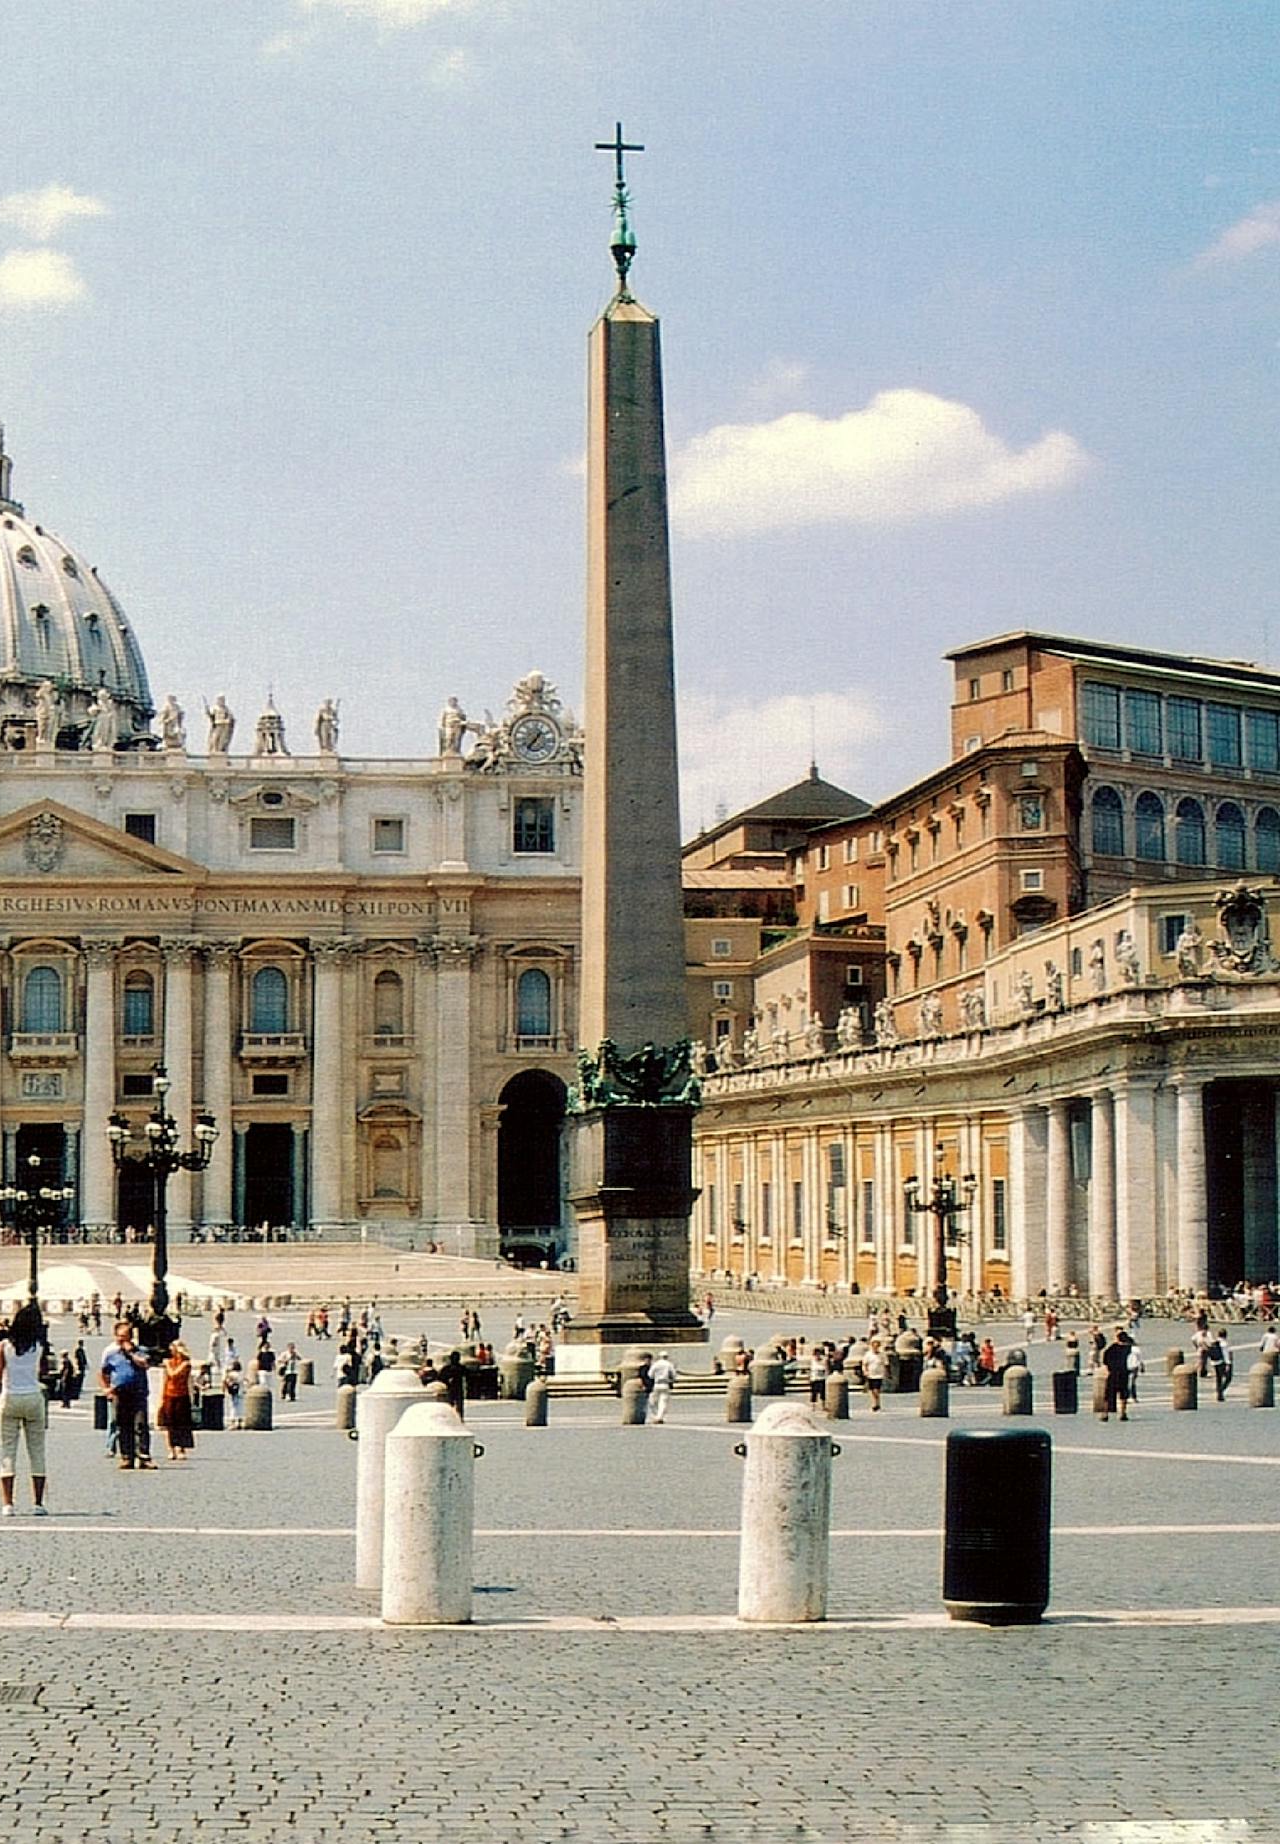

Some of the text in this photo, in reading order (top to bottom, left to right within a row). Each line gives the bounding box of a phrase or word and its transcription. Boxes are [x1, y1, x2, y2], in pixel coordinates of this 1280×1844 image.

[99, 897, 192, 912] ROMANVS
[195, 899, 241, 913] PONT
[243, 899, 282, 913] MAX
[286, 899, 309, 913] AN
[314, 899, 383, 915] MDCXII
[387, 901, 434, 915] PONT
[442, 899, 468, 912] VII
